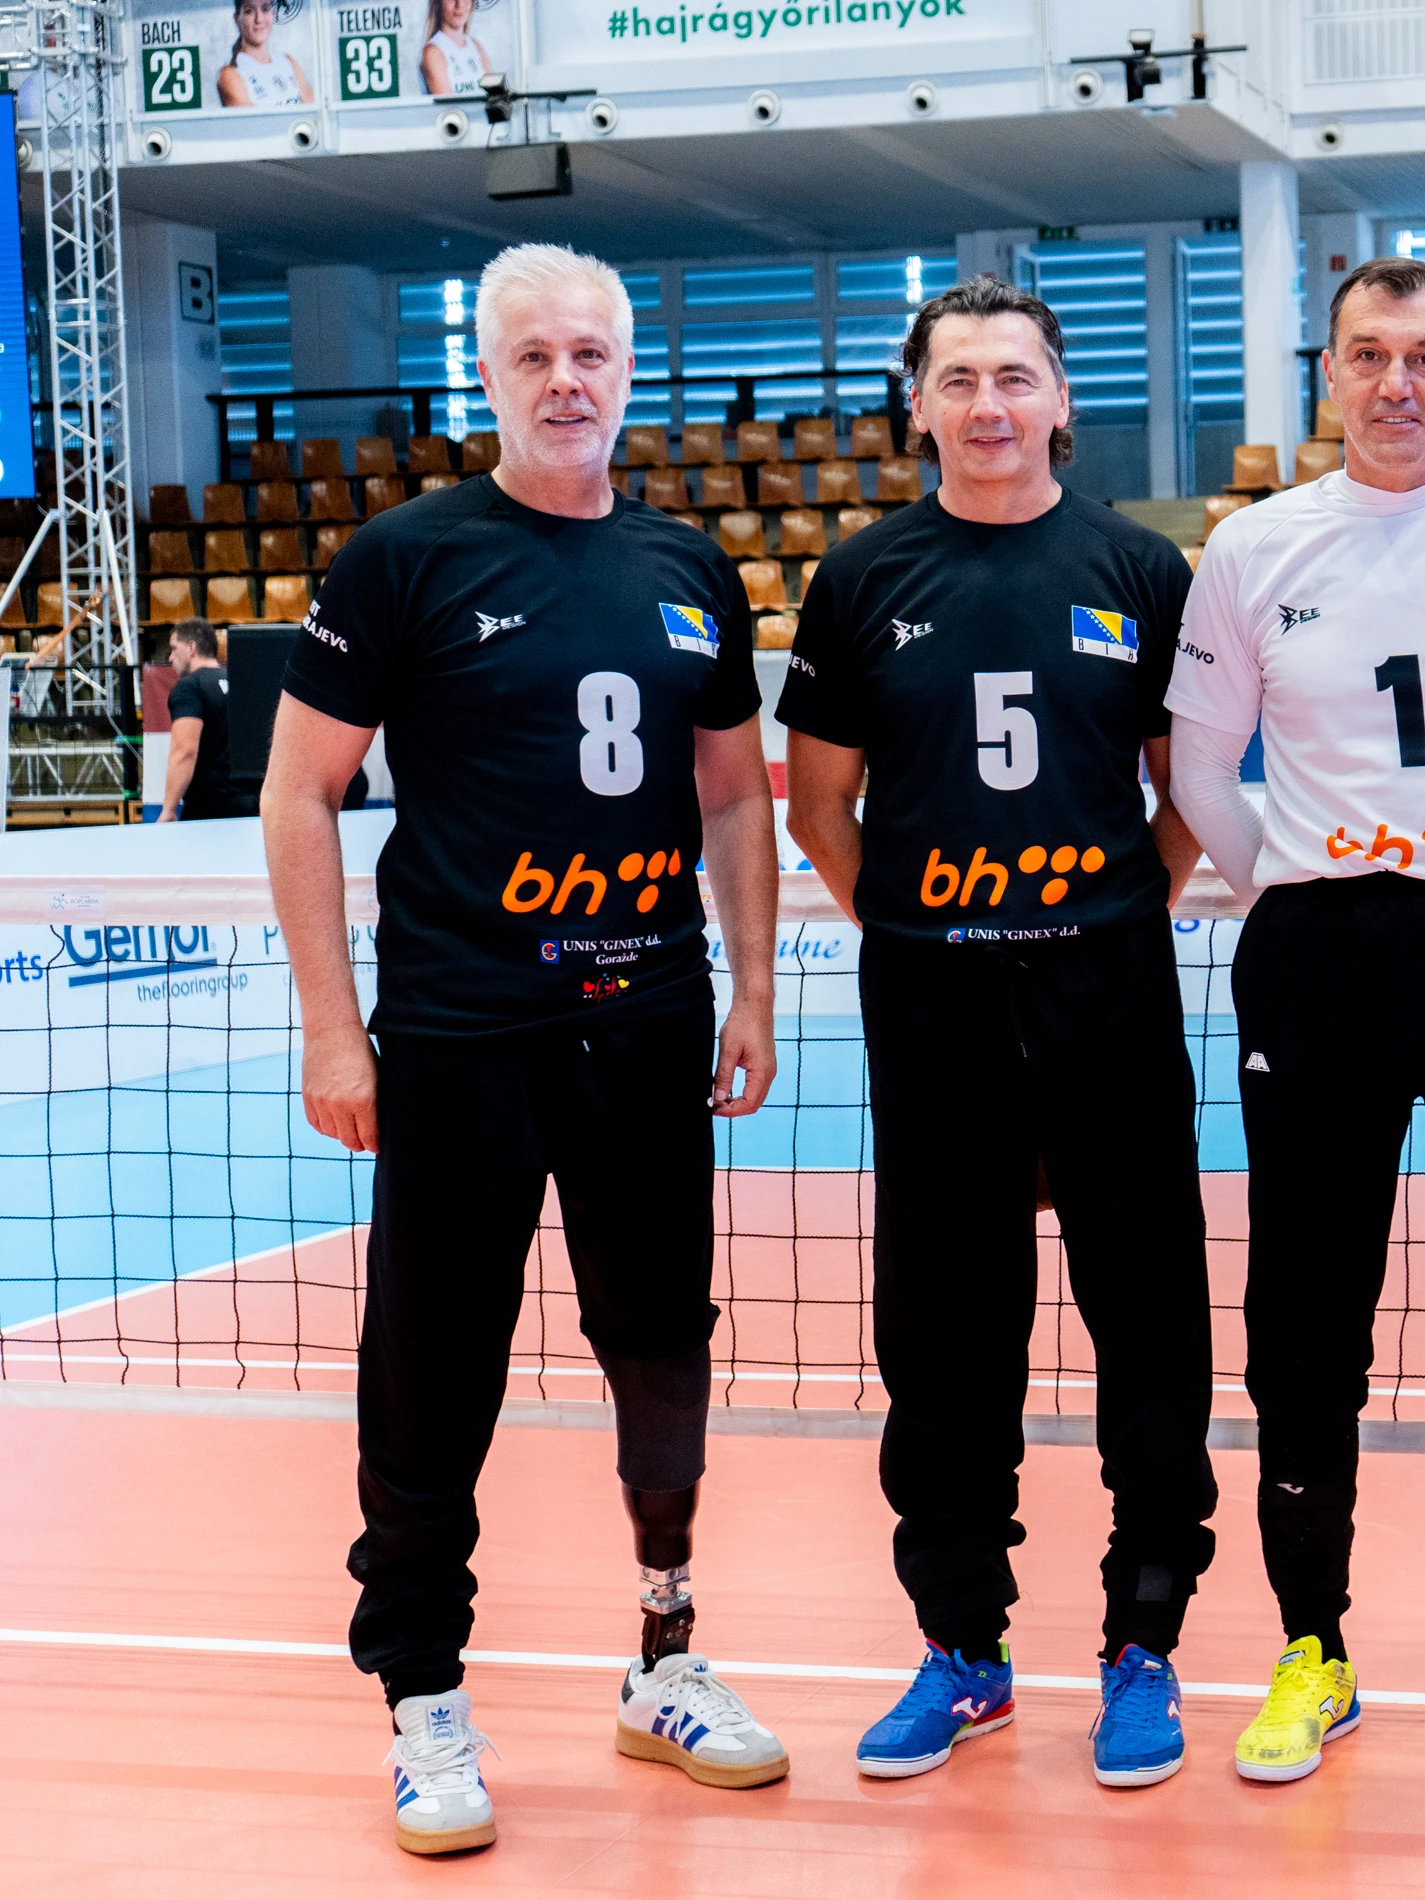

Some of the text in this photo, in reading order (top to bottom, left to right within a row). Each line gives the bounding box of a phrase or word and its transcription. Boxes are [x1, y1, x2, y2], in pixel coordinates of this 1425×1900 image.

[141, 20, 181, 45] BACH
[337, 6, 402, 33] TELENGA
[149, 48, 194, 105] 23
[345, 36, 393, 94] 33
[181, 263, 214, 324] B
[577, 671, 644, 796] 8
[973, 671, 1039, 791] 5
[502, 851, 607, 915] bh
[920, 846, 1010, 907] bh
[563, 940, 597, 952] UNIS
[600, 936, 644, 951] "GINEX"
[646, 933, 662, 947] d.d.
[968, 925, 1081, 941] UNIS "GINEX" d.d.
[0, 950, 43, 984] rts
[596, 951, 639, 965] Goražde
[137, 971, 249, 1003] thefooringroup
